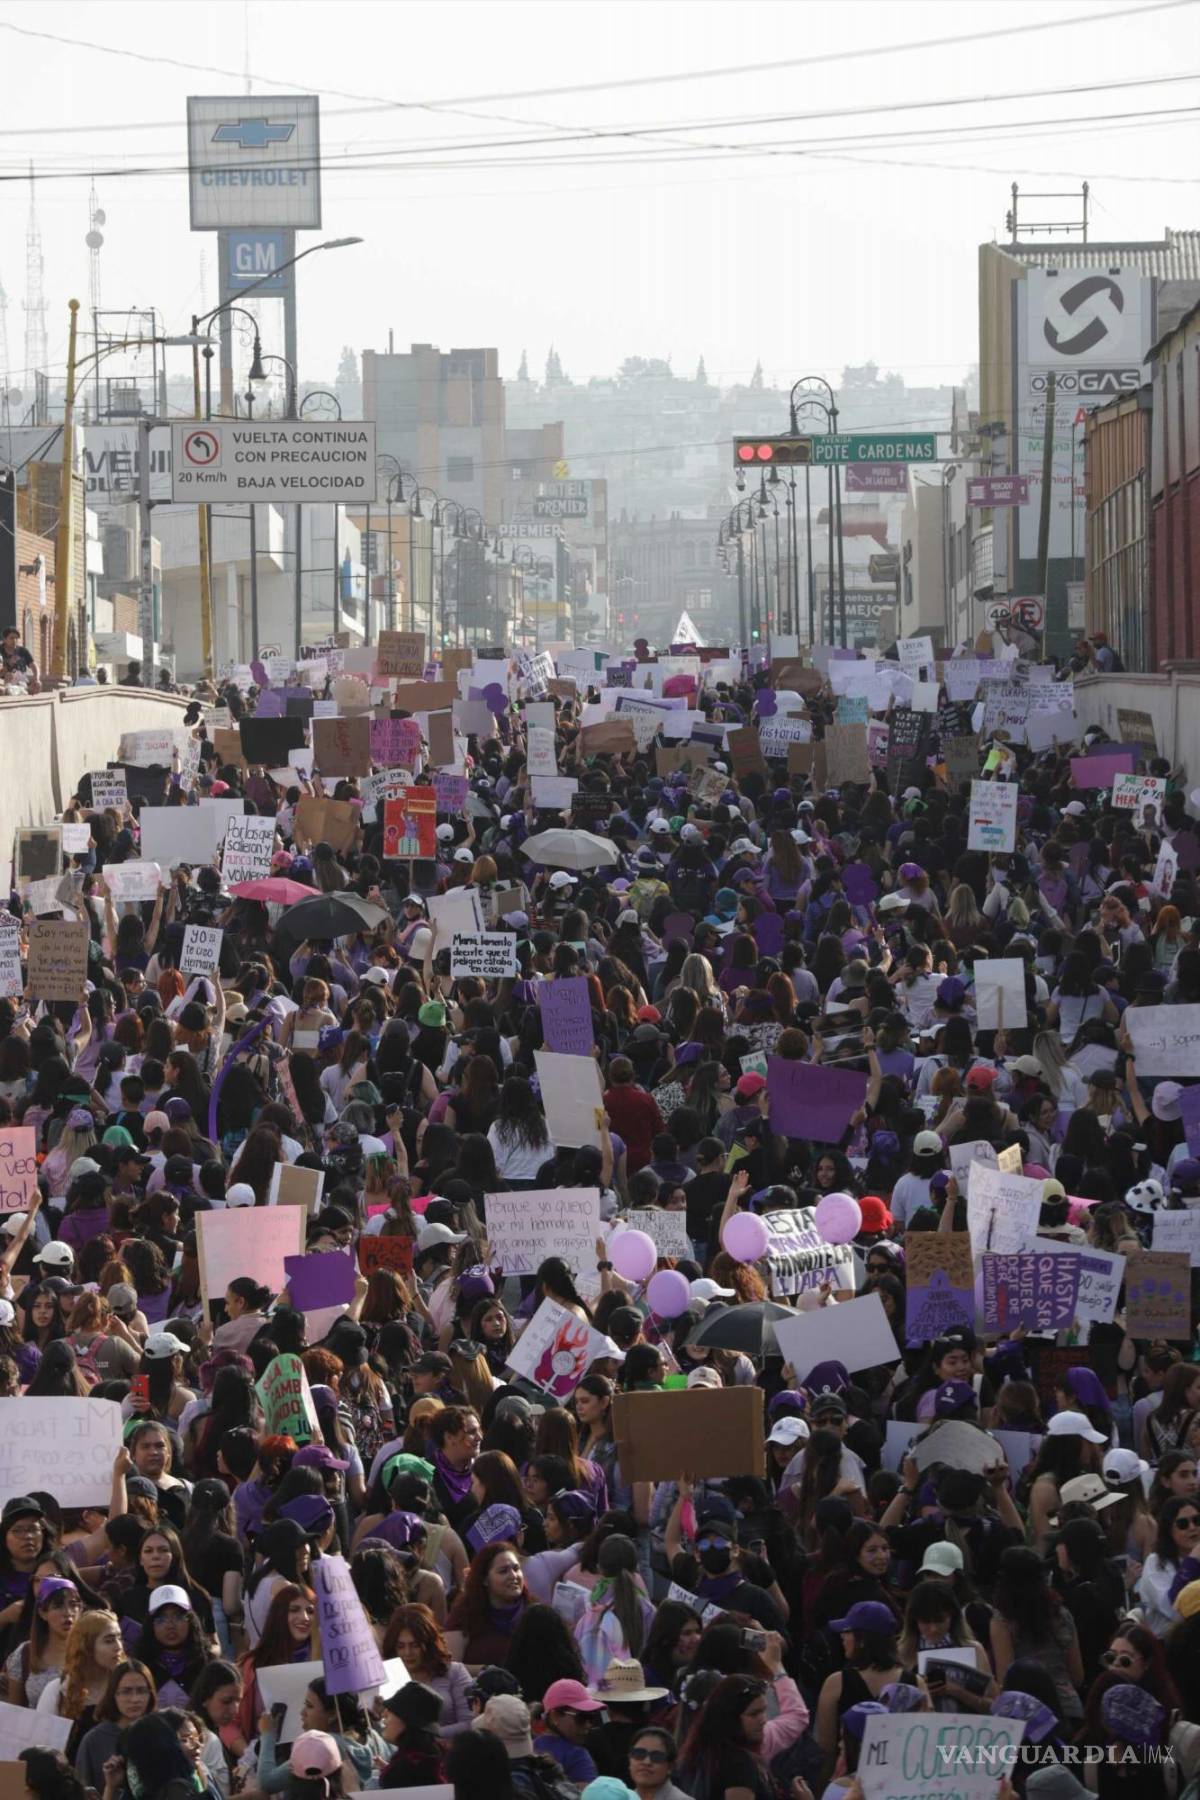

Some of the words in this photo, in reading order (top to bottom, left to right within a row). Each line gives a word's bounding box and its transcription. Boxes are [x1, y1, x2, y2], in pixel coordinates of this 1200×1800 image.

[201, 168, 307, 186] CHEVROLET
[236, 243, 276, 271] GM
[1079, 373, 1139, 390] GAS
[232, 432, 289, 444] VUELTA
[292, 431, 368, 444] CONTINUA
[816, 445, 849, 459] PDTE
[858, 443, 932, 459] CARDENAS
[1028, 441, 1070, 453] Mna
[234, 450, 266, 463] CON
[271, 450, 367, 463] PRECAUCION
[178, 472, 193, 483] 20
[196, 471, 227, 483] Km/h
[237, 476, 276, 489] BAJA
[280, 476, 365, 488] VELOCIDAD
[537, 501, 587, 516] PREMIER
[499, 524, 561, 537] PREMIER
[845, 605, 882, 617] MEJO
[990, 609, 1010, 618] 40
[228, 816, 243, 839] Por
[245, 817, 258, 840] las
[259, 830, 273, 843] que
[265, 844, 271, 857] y
[226, 855, 251, 865] nunca
[481, 935, 512, 946] lamento
[186, 944, 194, 955] te
[196, 947, 213, 957] creo
[453, 947, 483, 957] decirte
[486, 949, 501, 959] que
[502, 949, 510, 957] el
[453, 957, 483, 968] peligro
[484, 957, 512, 967] estaba
[483, 966, 504, 974] casa
[5, 1157, 36, 1176] veo
[488, 1194, 533, 1219] Porque
[538, 1201, 552, 1216] yo
[555, 1200, 593, 1219] quiero
[488, 1220, 506, 1236] que
[510, 1220, 524, 1231] mi
[531, 1217, 575, 1232] hermana
[512, 1238, 547, 1255] amigas
[553, 1237, 593, 1254] regresen
[994, 1255, 1009, 1284] SER
[1006, 1255, 1021, 1294] DEJE
[1037, 1256, 1055, 1296] QUE
[1019, 1255, 1037, 1312] MUJER
[1055, 1256, 1078, 1320] HASTA
[1008, 1297, 1020, 1315] DE
[1035, 1298, 1053, 1328] SER
[867, 1740, 888, 1765] MI
[903, 1725, 1011, 1780] CUERPO
